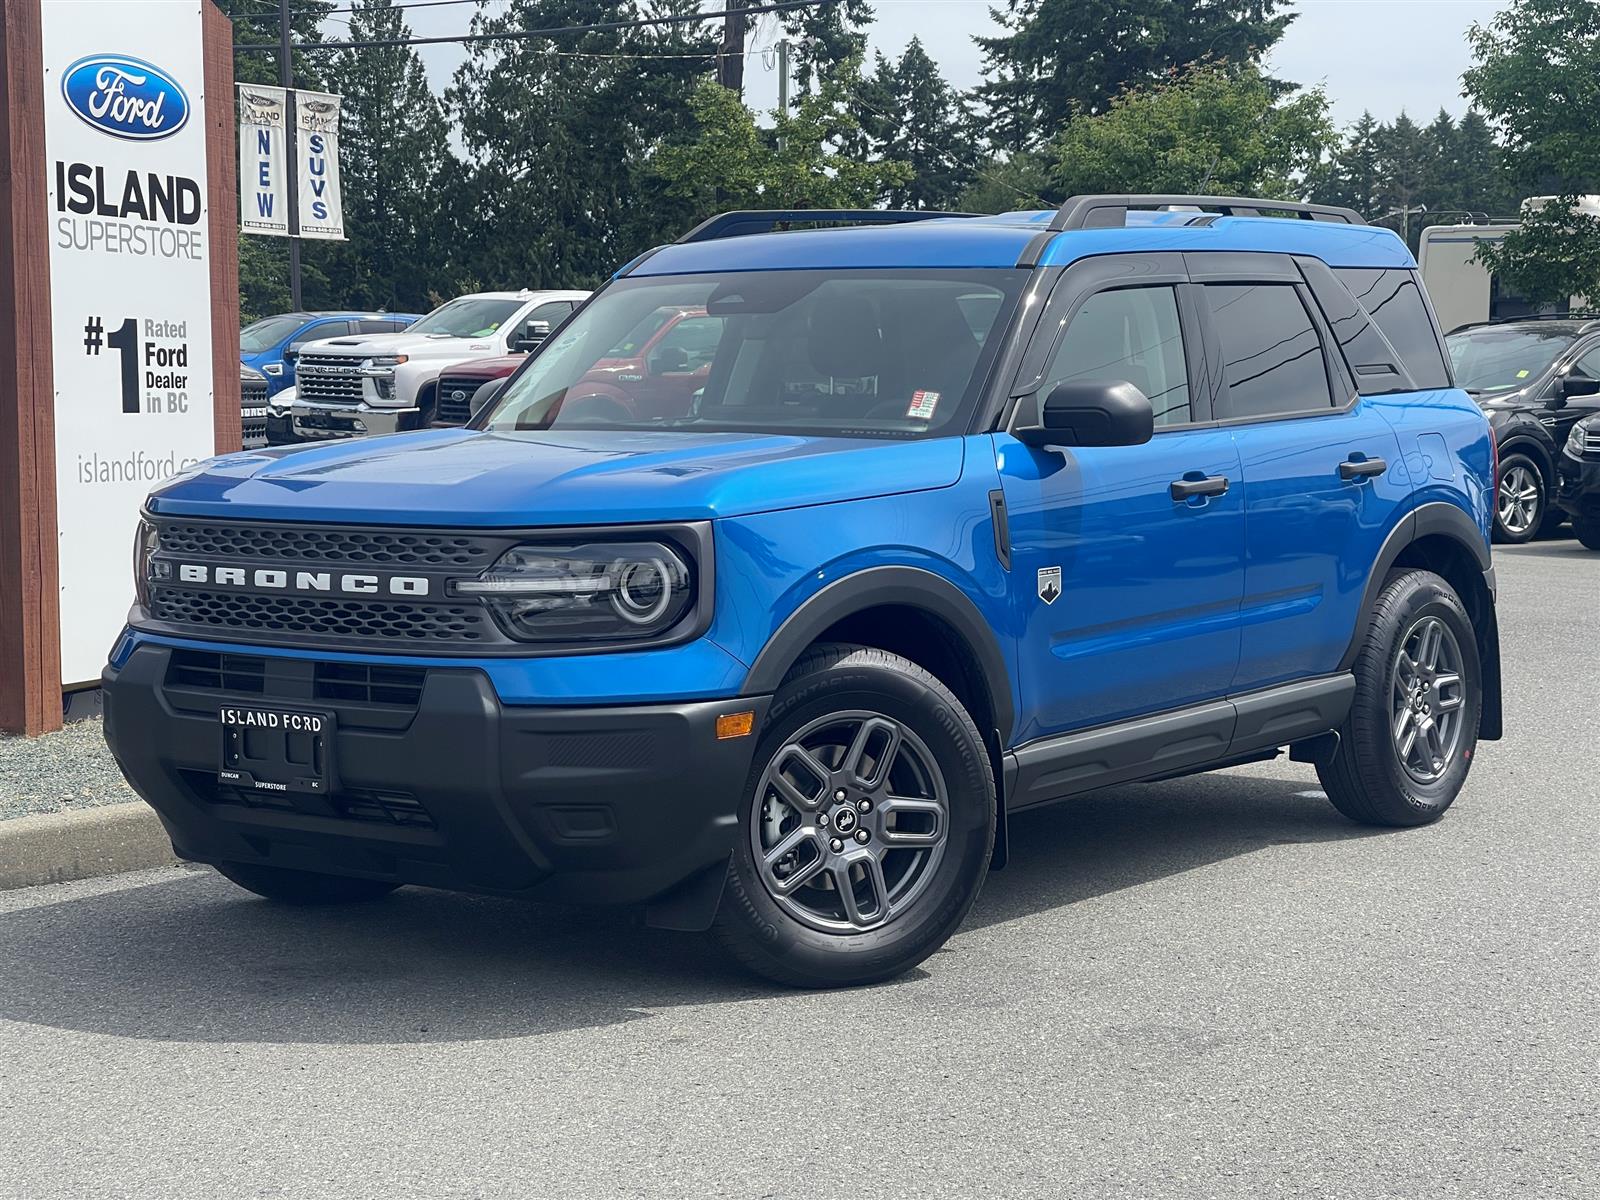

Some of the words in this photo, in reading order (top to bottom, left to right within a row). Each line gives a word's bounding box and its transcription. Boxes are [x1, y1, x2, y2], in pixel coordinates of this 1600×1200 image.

[88, 66, 165, 128] Ford
[257, 130, 273, 218] NEW
[309, 134, 328, 220] SUVS
[56, 161, 201, 226] ISLAND
[57, 217, 202, 260] SUPERSTORE
[144, 319, 187, 339] Rated
[84, 316, 140, 414] #1
[145, 342, 188, 367] Ford
[146, 371, 188, 389] Dealer
[146, 392, 162, 413] in
[167, 392, 188, 413] BC
[78, 450, 199, 483] islandfordc
[179, 564, 429, 596] BRONCO
[221, 709, 279, 728] ISLAND
[283, 714, 321, 732] FORD
[254, 781, 287, 791] SUPERSTORE
